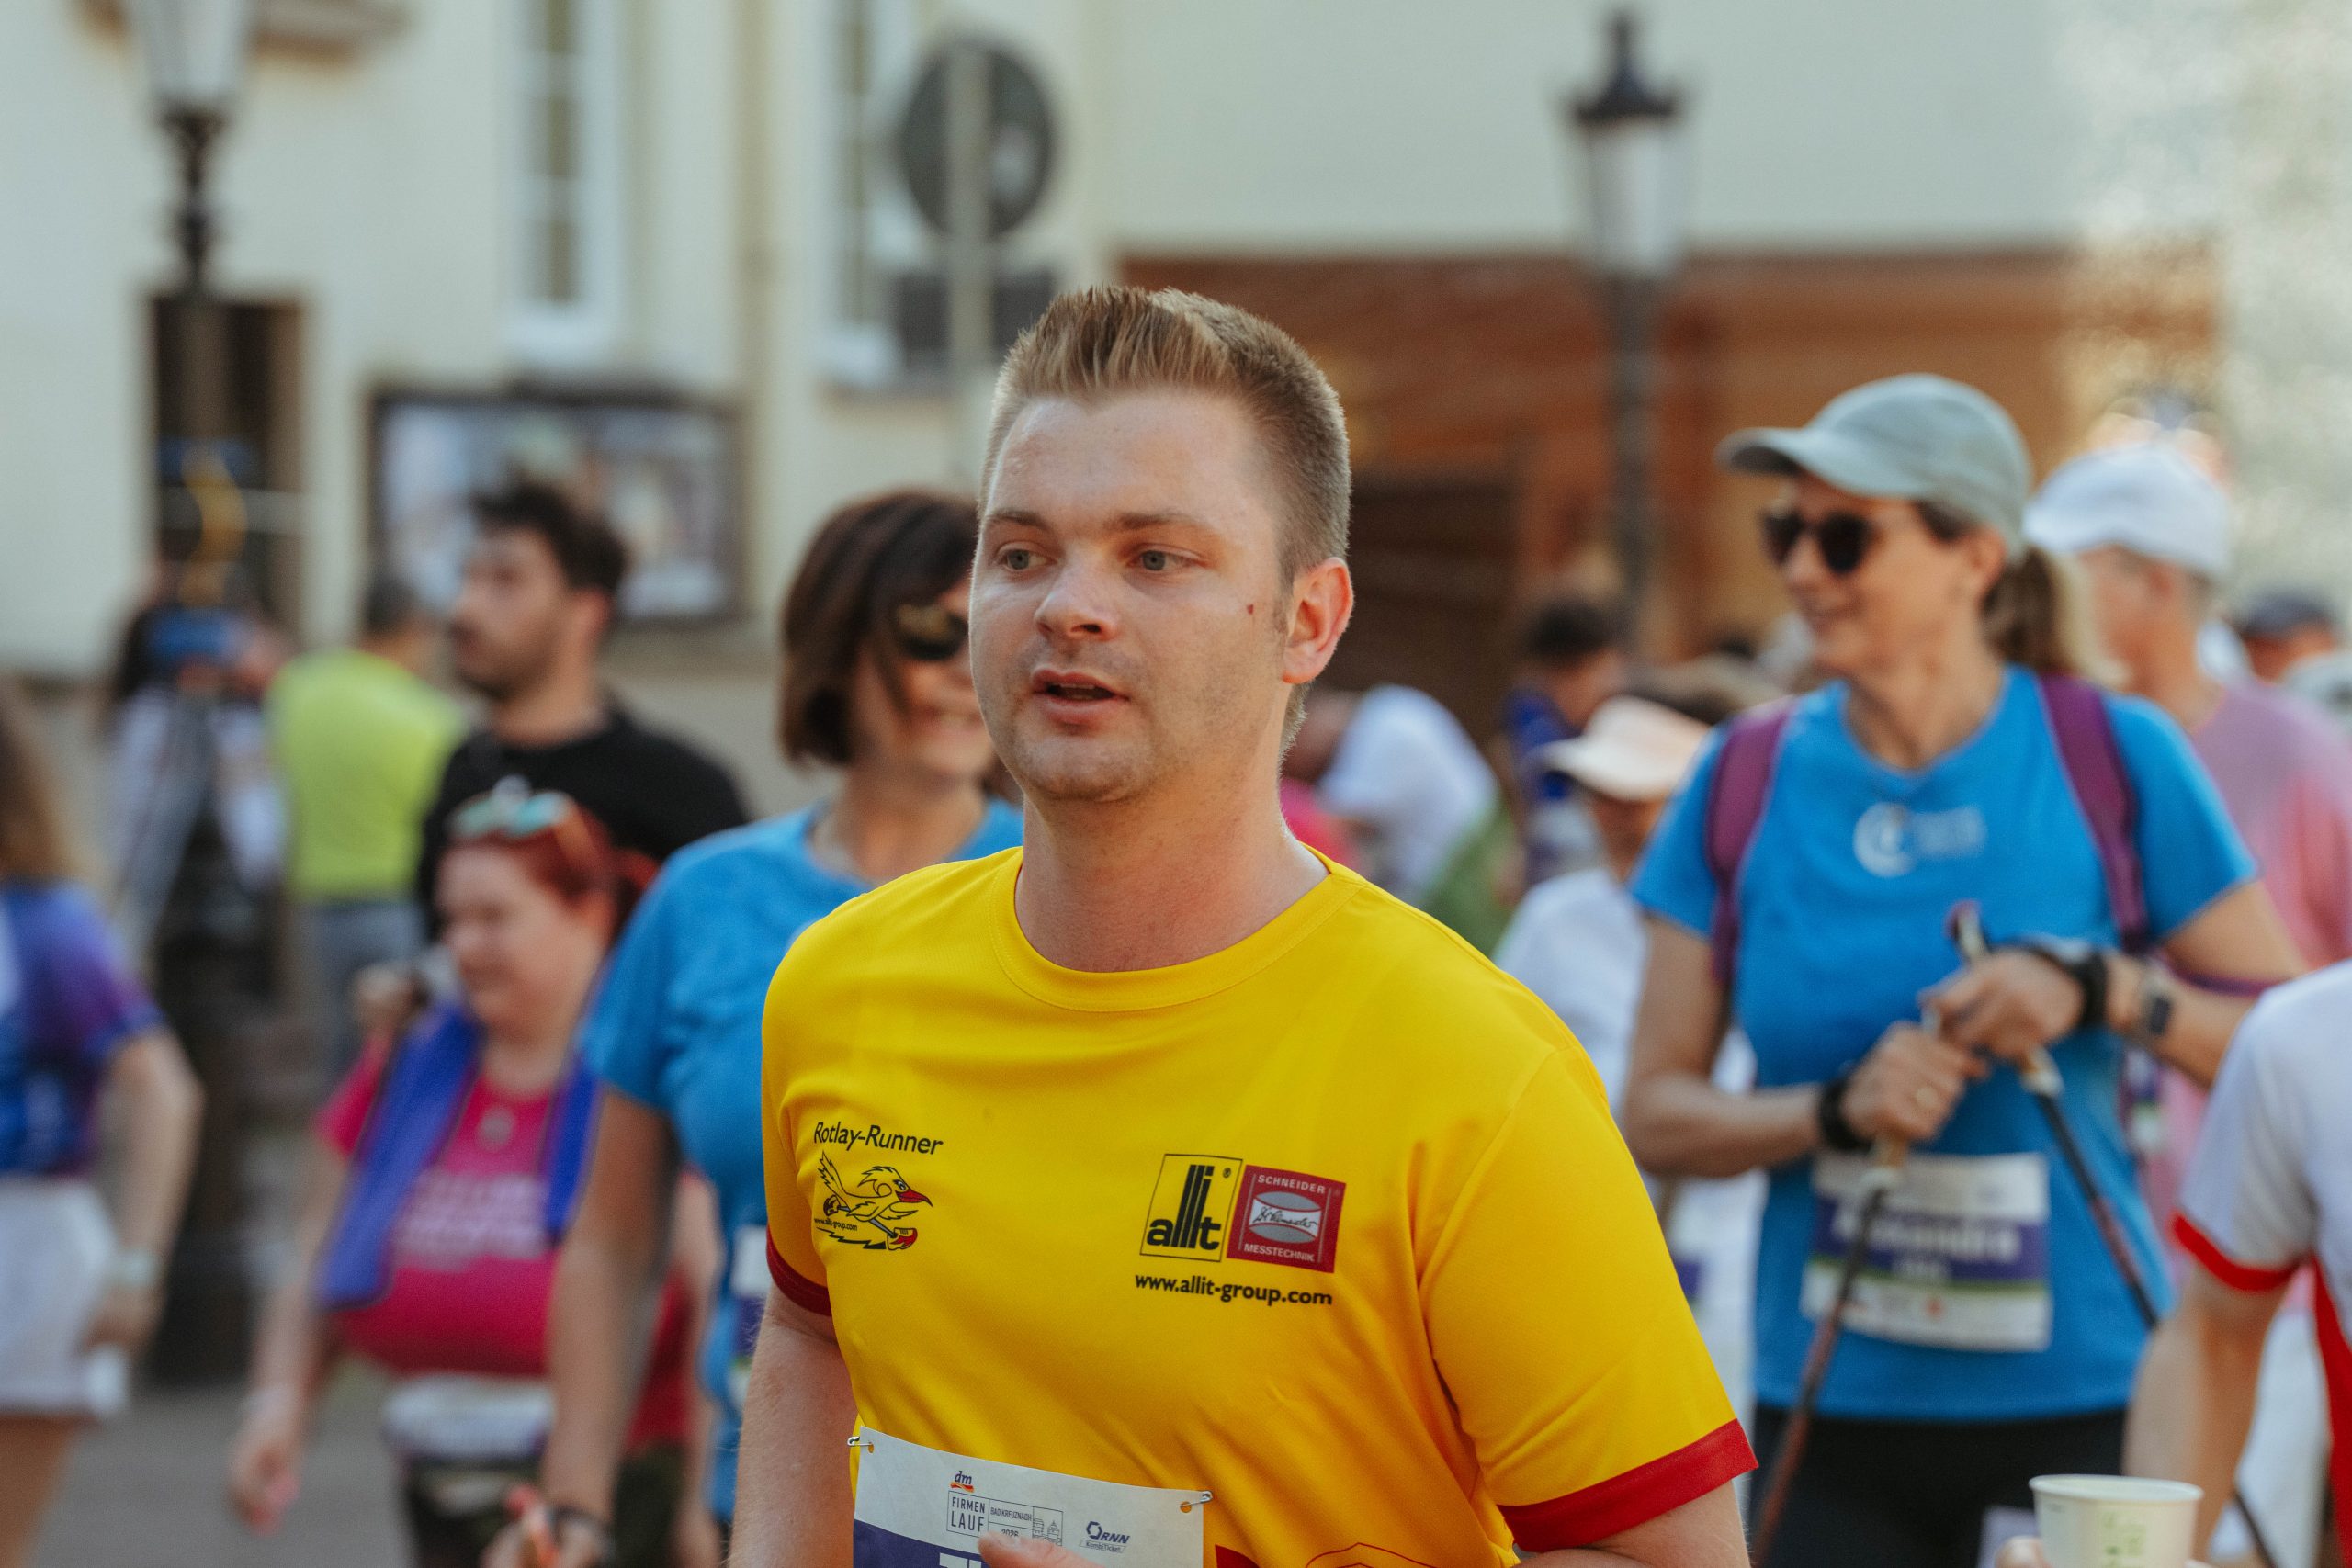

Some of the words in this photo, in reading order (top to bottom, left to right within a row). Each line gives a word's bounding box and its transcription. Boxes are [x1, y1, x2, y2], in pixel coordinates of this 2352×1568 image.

[814, 1122, 944, 1155] Rotlay-Runner
[1258, 1175, 1326, 1194] SCHNEIDER
[1147, 1164, 1221, 1250] allit
[1244, 1243, 1315, 1262] MESSTECHNIK
[1136, 1275, 1332, 1306] www.allit-group.com
[955, 1471, 973, 1485] dm
[952, 1496, 986, 1514] FIRMEN
[990, 1506, 1001, 1517] BAD
[1001, 1509, 1032, 1521] KREUZNACH
[951, 1511, 985, 1532] LAUF
